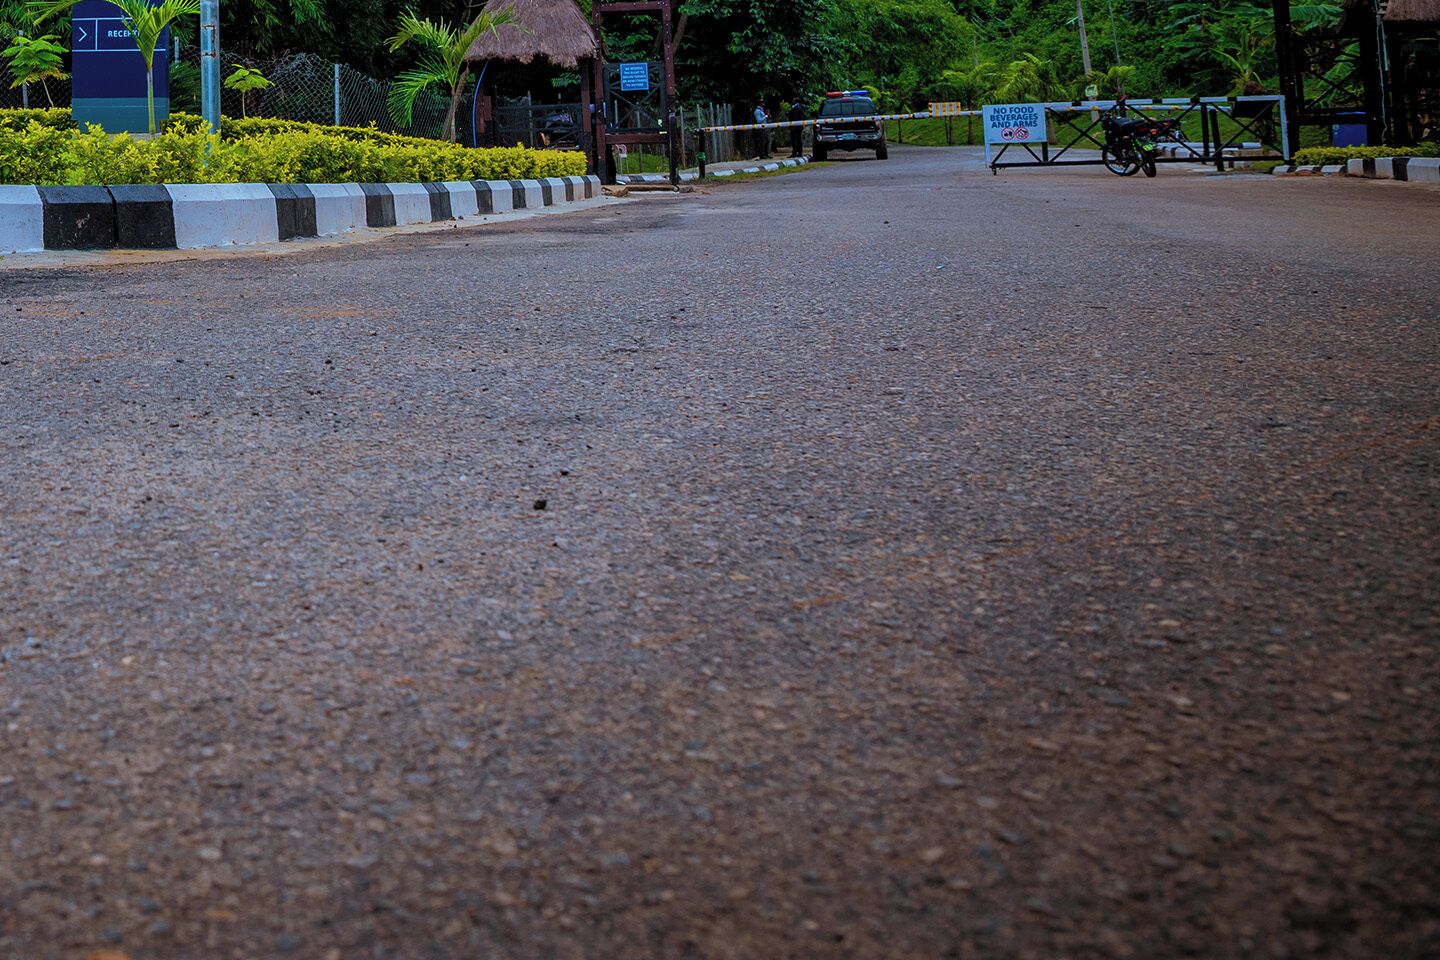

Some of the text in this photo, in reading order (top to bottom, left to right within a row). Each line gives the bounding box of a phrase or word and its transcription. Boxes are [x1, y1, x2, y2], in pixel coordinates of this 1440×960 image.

[1009, 106, 1034, 114] FOOD
[990, 113, 1039, 121] BEVERAGES
[991, 120, 1038, 129] AND ARMS
